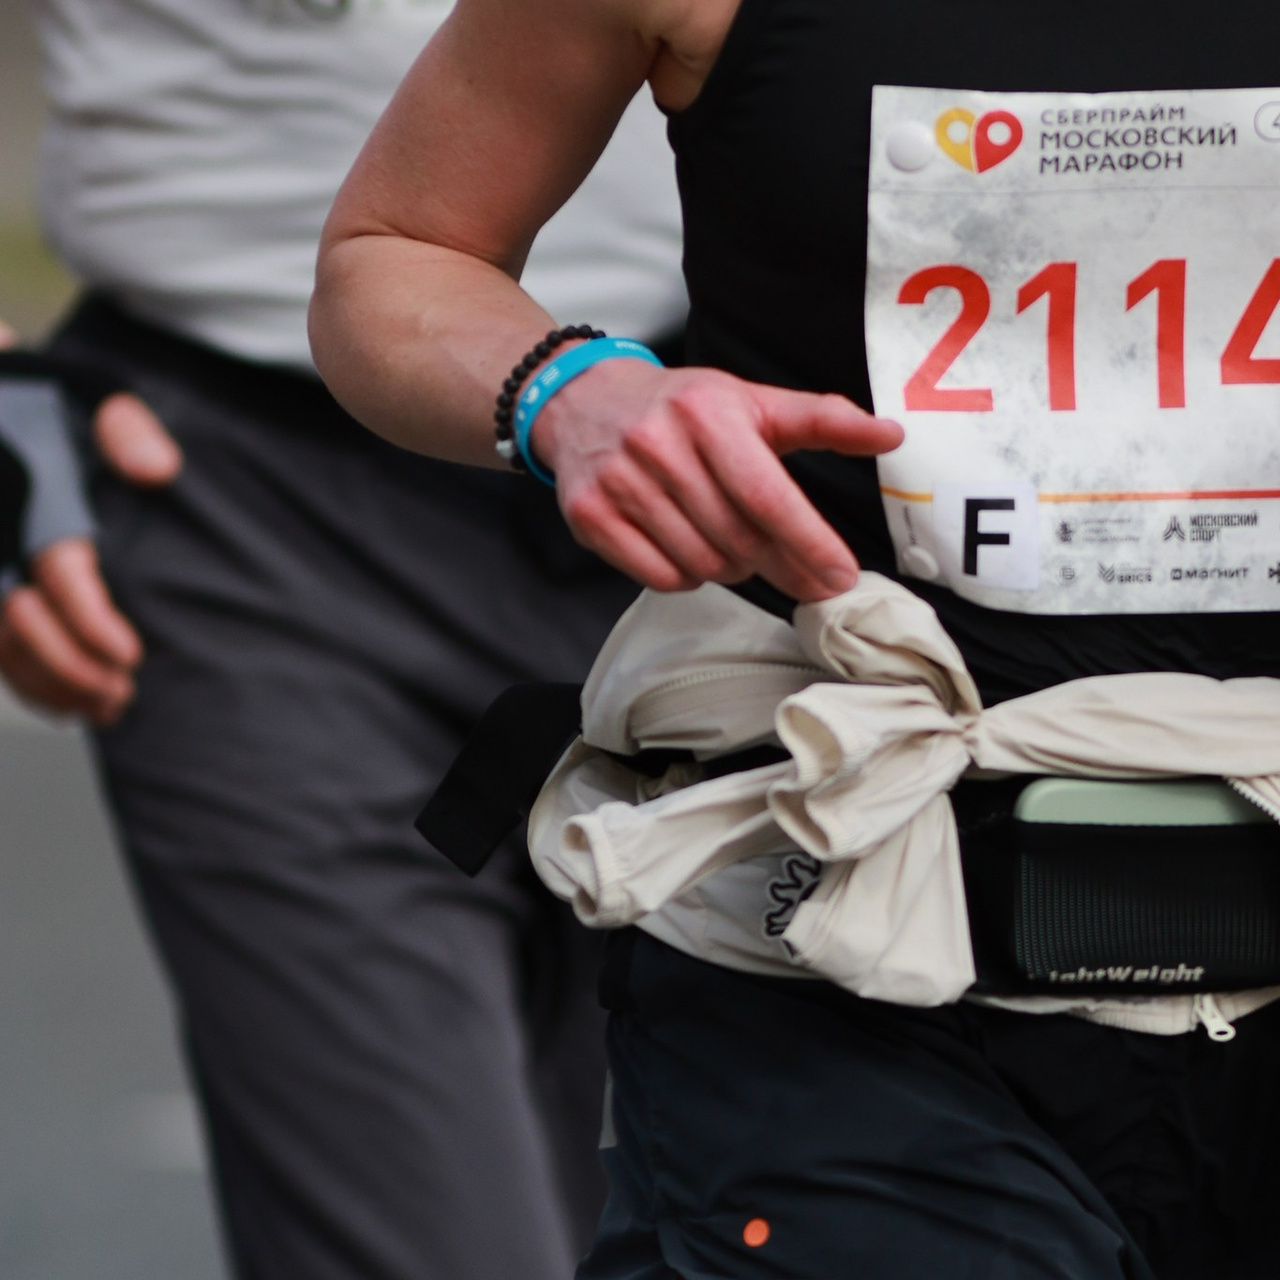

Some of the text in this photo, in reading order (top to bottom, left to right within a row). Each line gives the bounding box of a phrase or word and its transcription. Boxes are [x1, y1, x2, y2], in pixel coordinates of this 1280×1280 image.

[1039, 103, 1186, 126] СБЕРПРАЙМ
[1039, 122, 1238, 151] МОСКОВСКИЙ
[1039, 150, 1184, 174] МАРАФОН
[963, 498, 1016, 577] F
